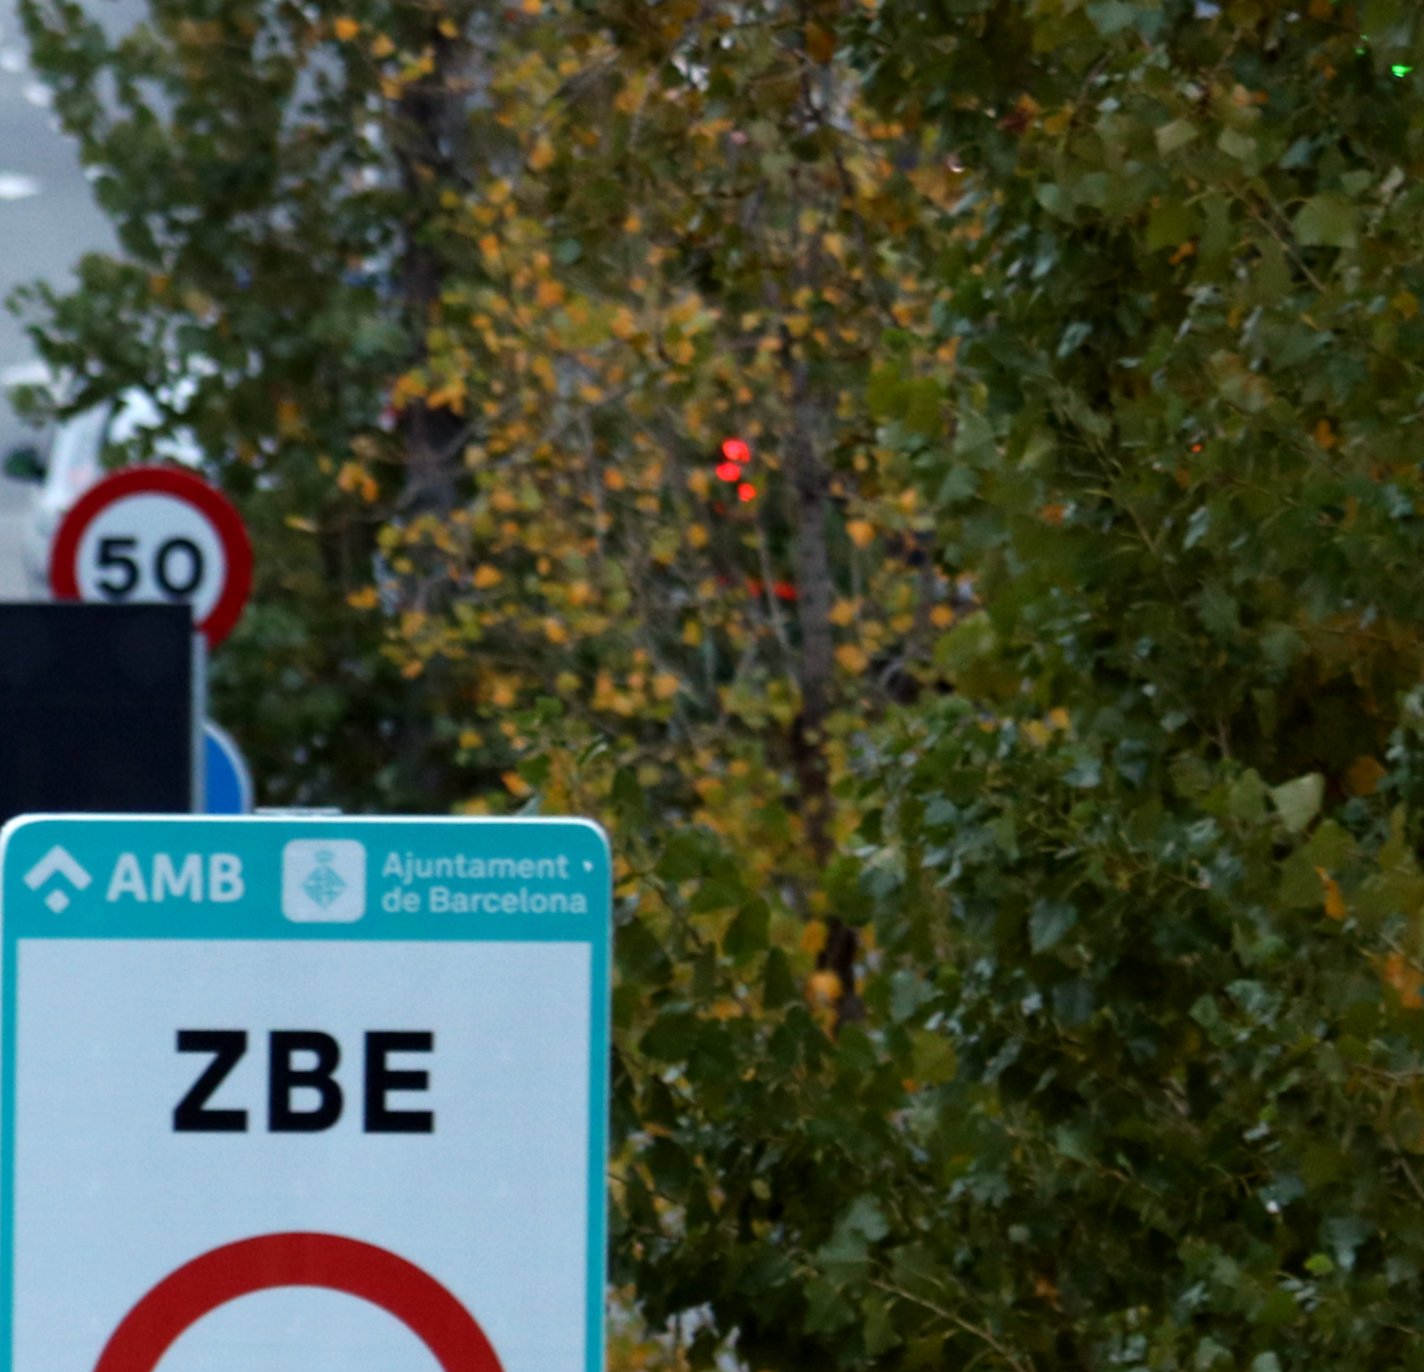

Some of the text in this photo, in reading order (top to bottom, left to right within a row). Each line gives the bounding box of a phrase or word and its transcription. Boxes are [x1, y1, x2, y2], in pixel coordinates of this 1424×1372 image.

[96, 536, 205, 596] 50
[107, 853, 244, 902] AMB
[383, 852, 568, 884] Ajuntament
[382, 886, 586, 913] de Barcelona
[172, 1029, 434, 1134] ZBE
